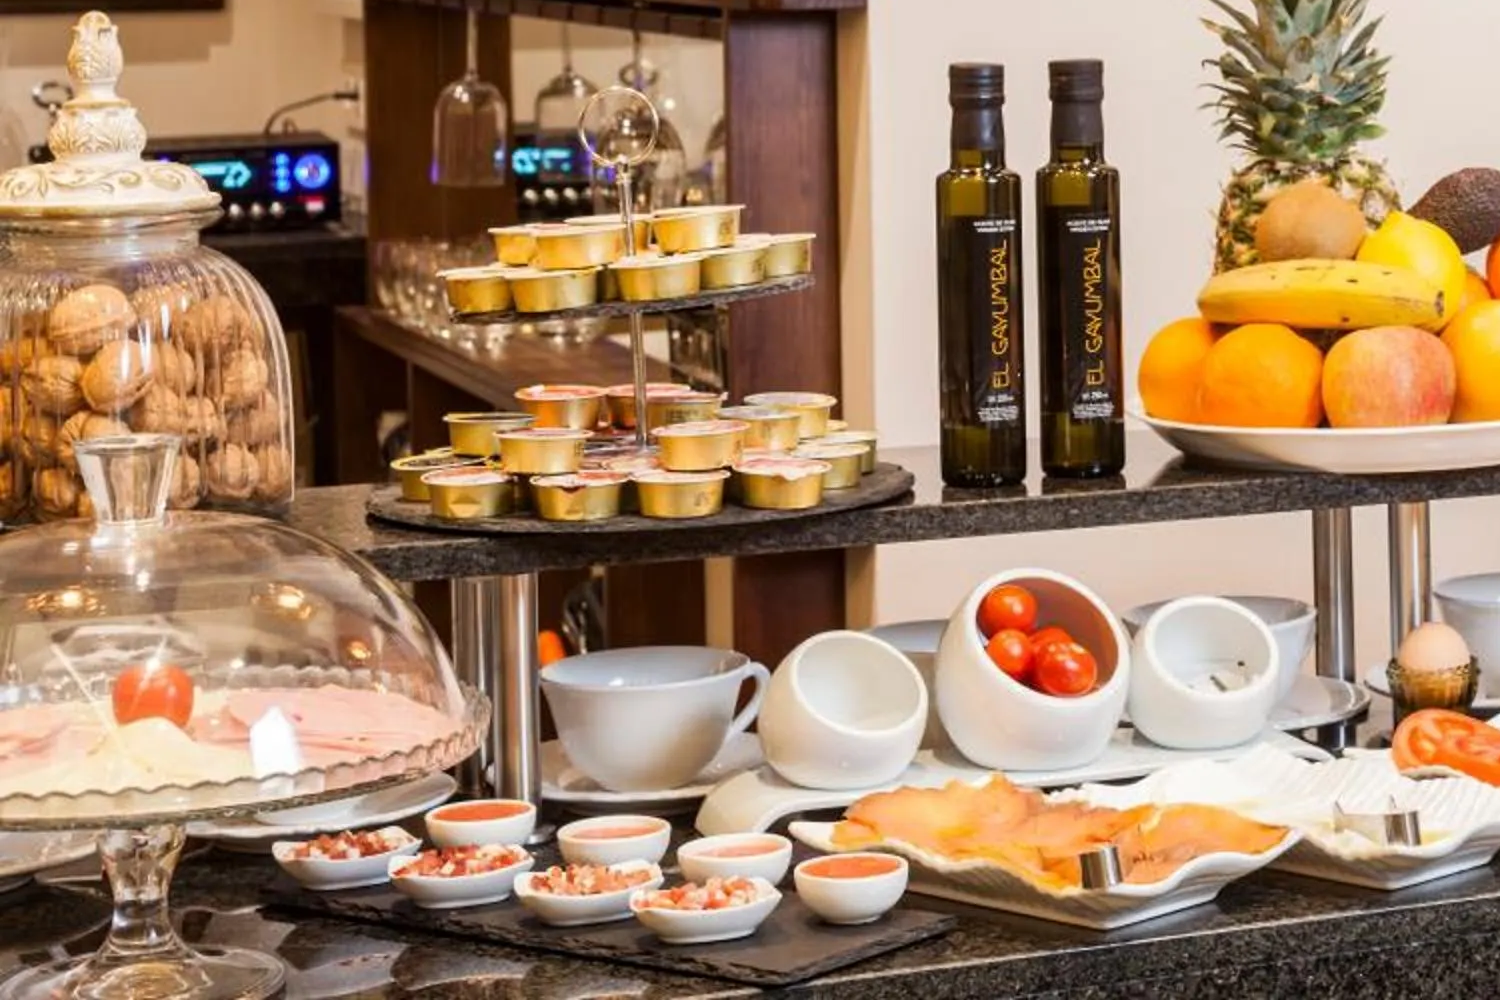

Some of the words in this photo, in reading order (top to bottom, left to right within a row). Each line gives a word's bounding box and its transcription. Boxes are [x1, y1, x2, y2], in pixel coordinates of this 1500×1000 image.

[990, 239, 1009, 356] GAYUMBAL
[1083, 238, 1104, 354] GAYUMBAL
[993, 361, 1010, 389] EL
[1085, 359, 1105, 386] EL
